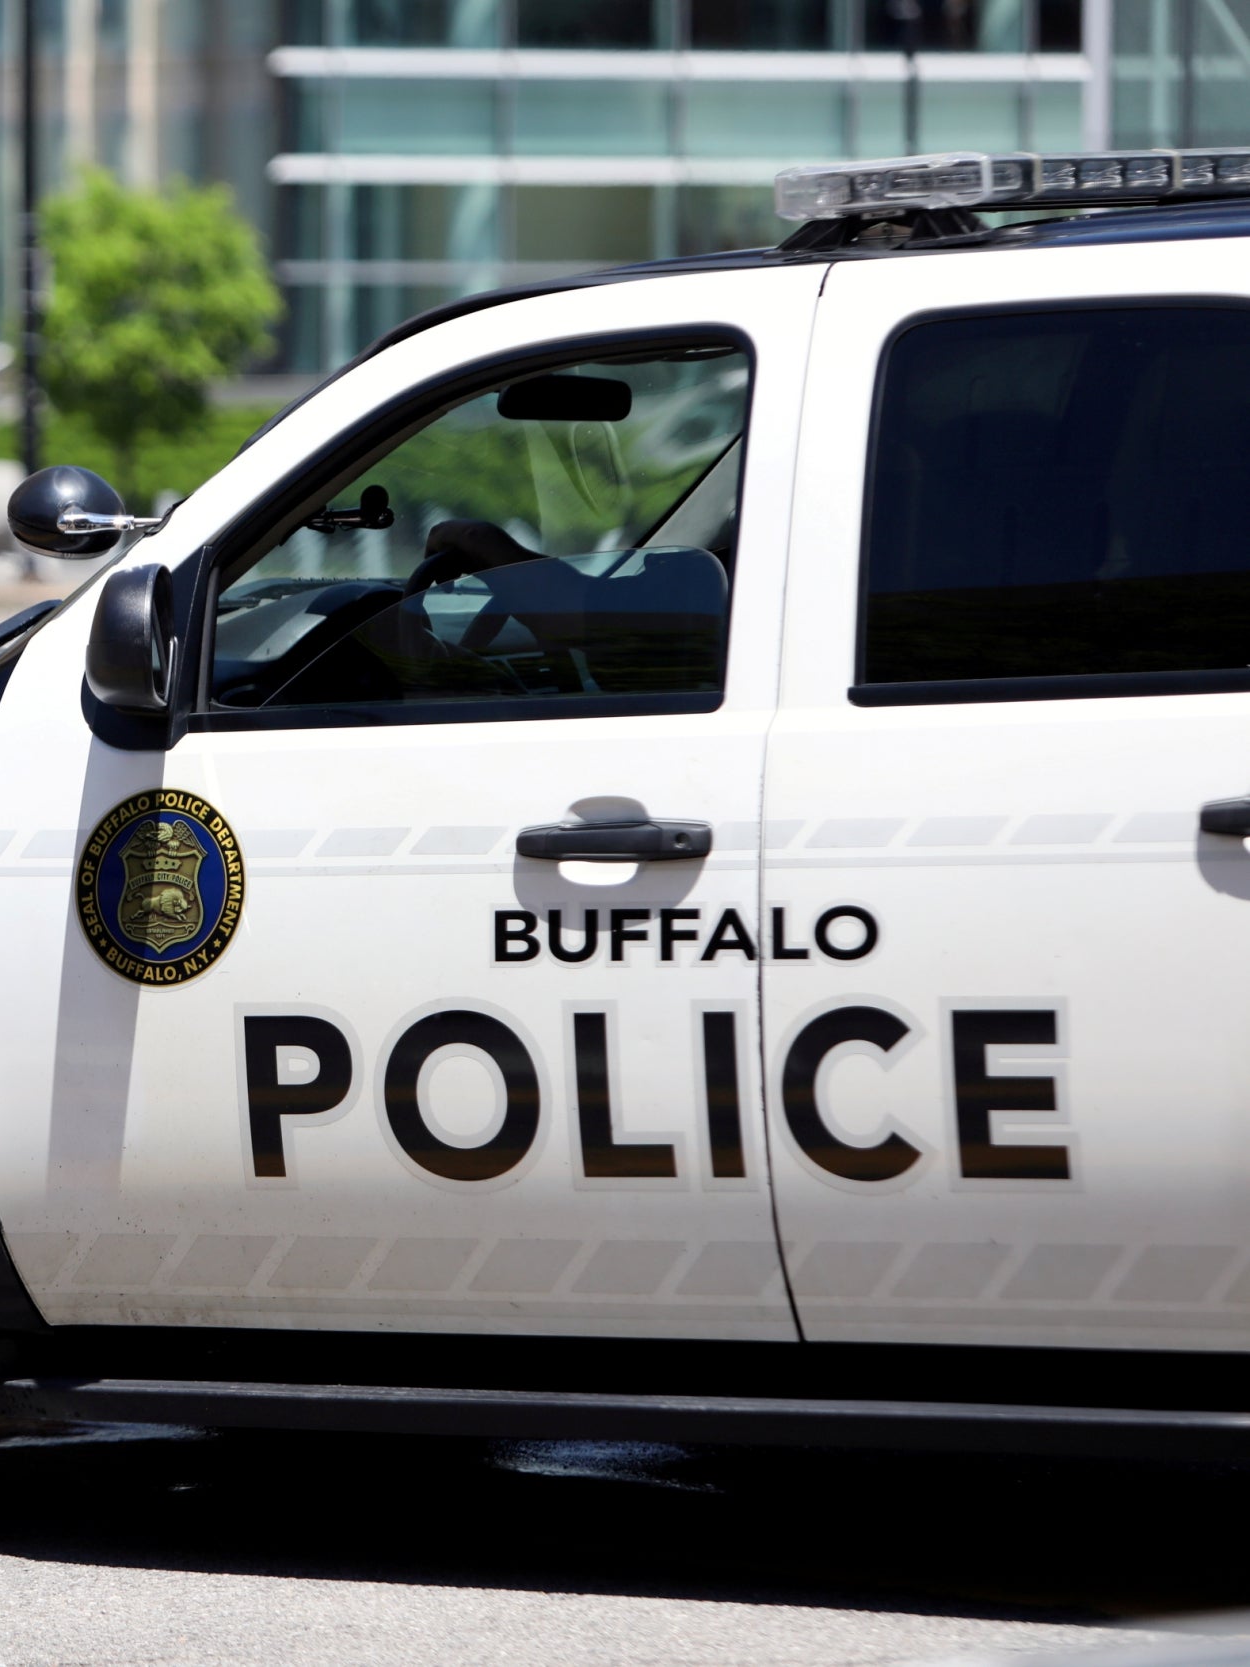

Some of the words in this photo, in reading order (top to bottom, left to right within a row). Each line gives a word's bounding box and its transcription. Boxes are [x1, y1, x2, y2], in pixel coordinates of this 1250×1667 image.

[88, 796, 150, 856] BUFFALO
[156, 793, 210, 820] POLICE
[81, 864, 96, 885] OF
[209, 818, 242, 937] DEPARTMENT
[81, 892, 103, 936] SEAL
[493, 906, 877, 962] BUFFALO
[106, 947, 183, 981] BUFFALO,
[184, 951, 214, 975] N.Y.
[244, 1006, 1070, 1182] POLICE
